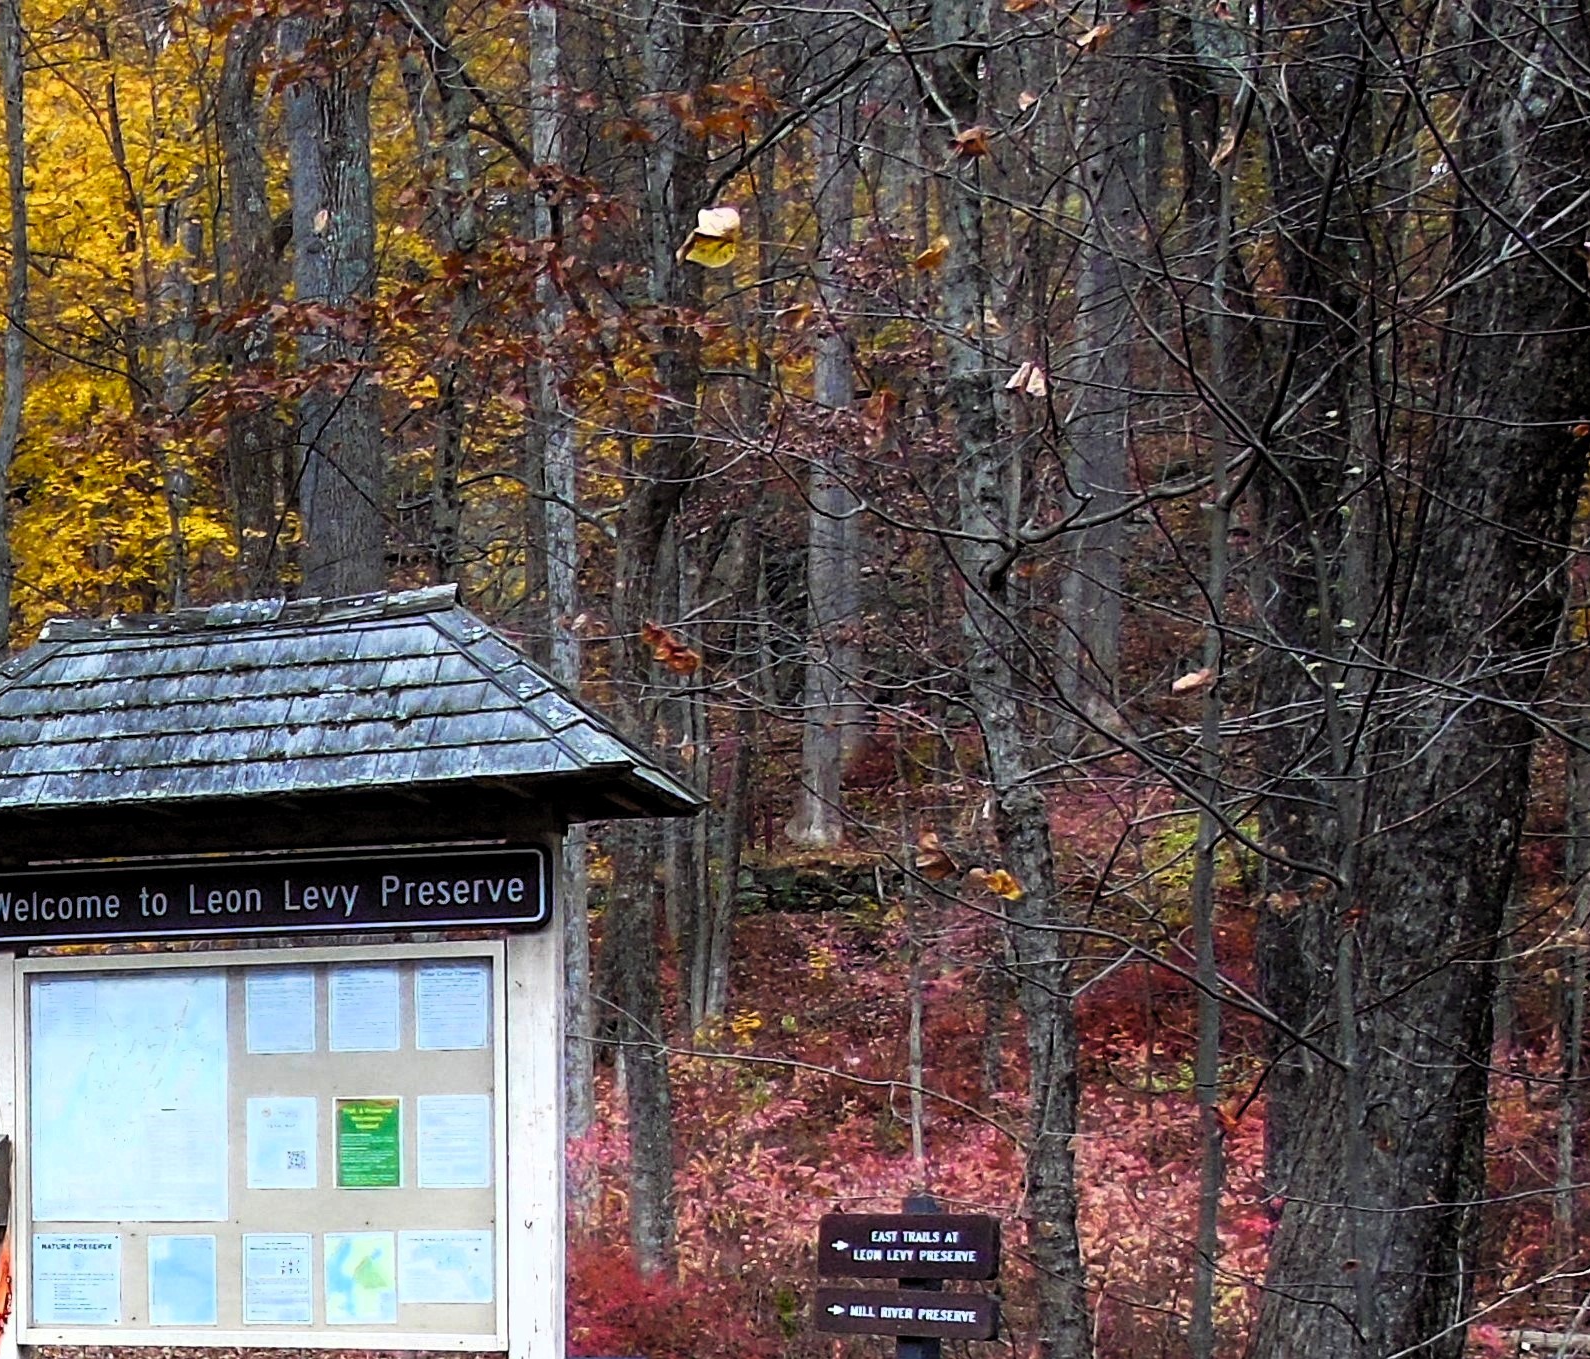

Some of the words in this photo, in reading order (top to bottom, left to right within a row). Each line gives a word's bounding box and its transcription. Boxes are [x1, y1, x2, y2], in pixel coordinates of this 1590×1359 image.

[139, 886, 167, 917] to
[189, 884, 261, 914] Leon
[284, 880, 359, 917] Levy
[381, 875, 524, 907] Preserve
[871, 1230, 898, 1243] EAST
[903, 1230, 940, 1243] TRAILS
[944, 1230, 959, 1243] AT
[853, 1249, 882, 1261] LEON
[886, 1249, 914, 1261] LEVY
[919, 1250, 977, 1262] PRESERVE
[849, 1305, 876, 1318] MILL
[880, 1307, 913, 1320] RIVER
[918, 1308, 977, 1323] PRESERVE
